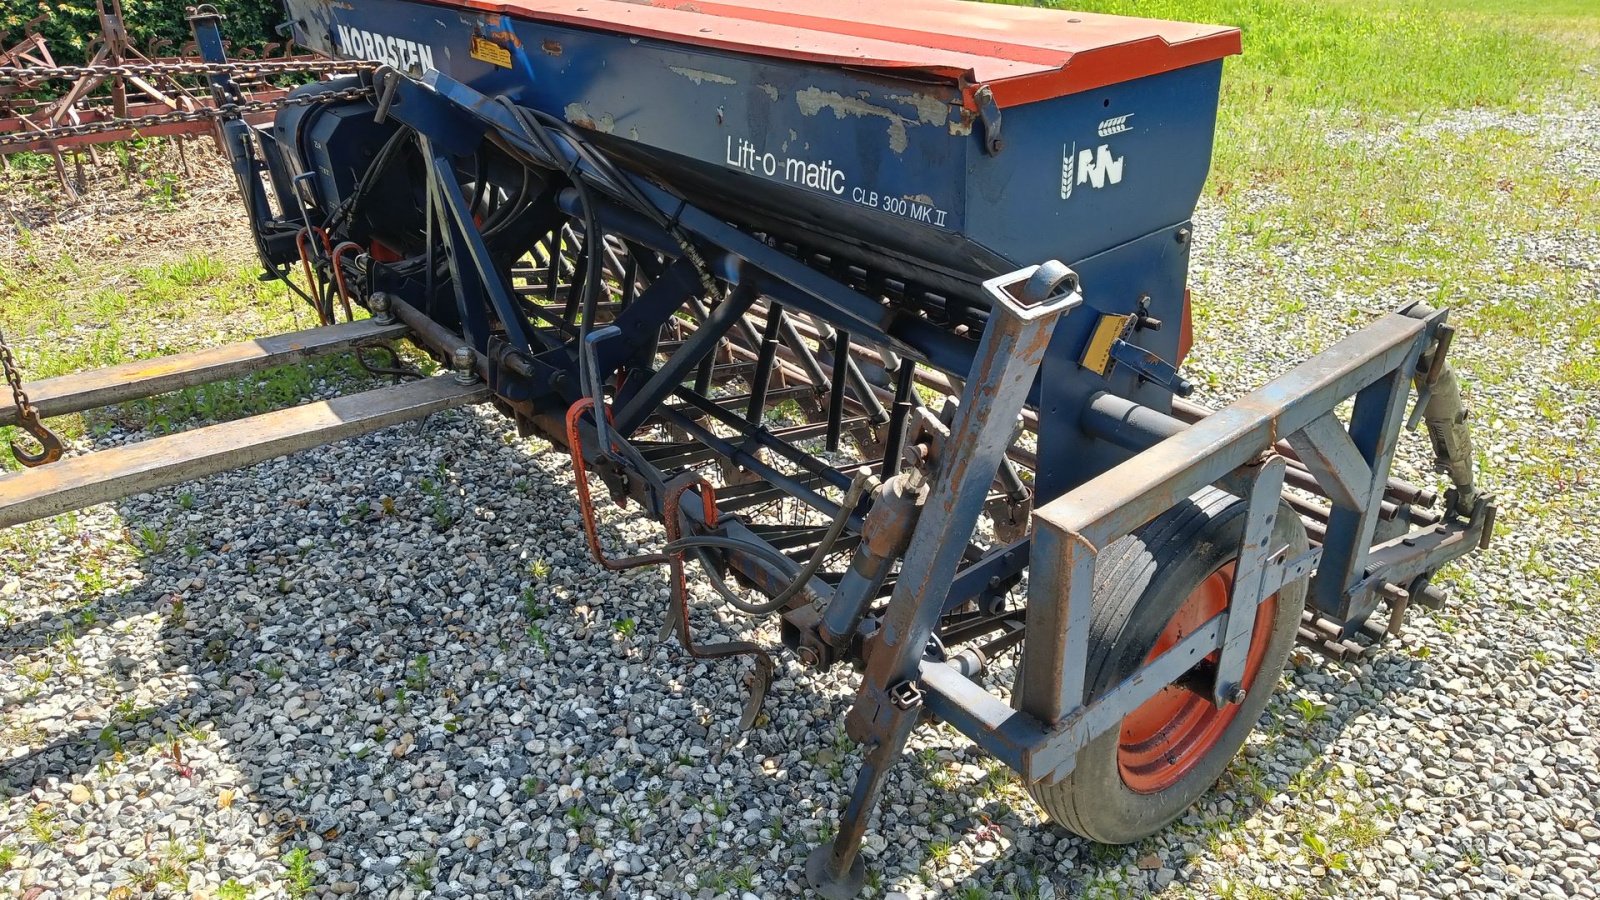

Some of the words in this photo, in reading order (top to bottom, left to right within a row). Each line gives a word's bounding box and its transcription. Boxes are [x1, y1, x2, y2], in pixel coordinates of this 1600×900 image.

[337, 24, 435, 75] NORDSTEN
[852, 186, 878, 208] CLB
[882, 195, 907, 216] 300
[910, 203, 932, 224] MK
[934, 209, 948, 228] II
